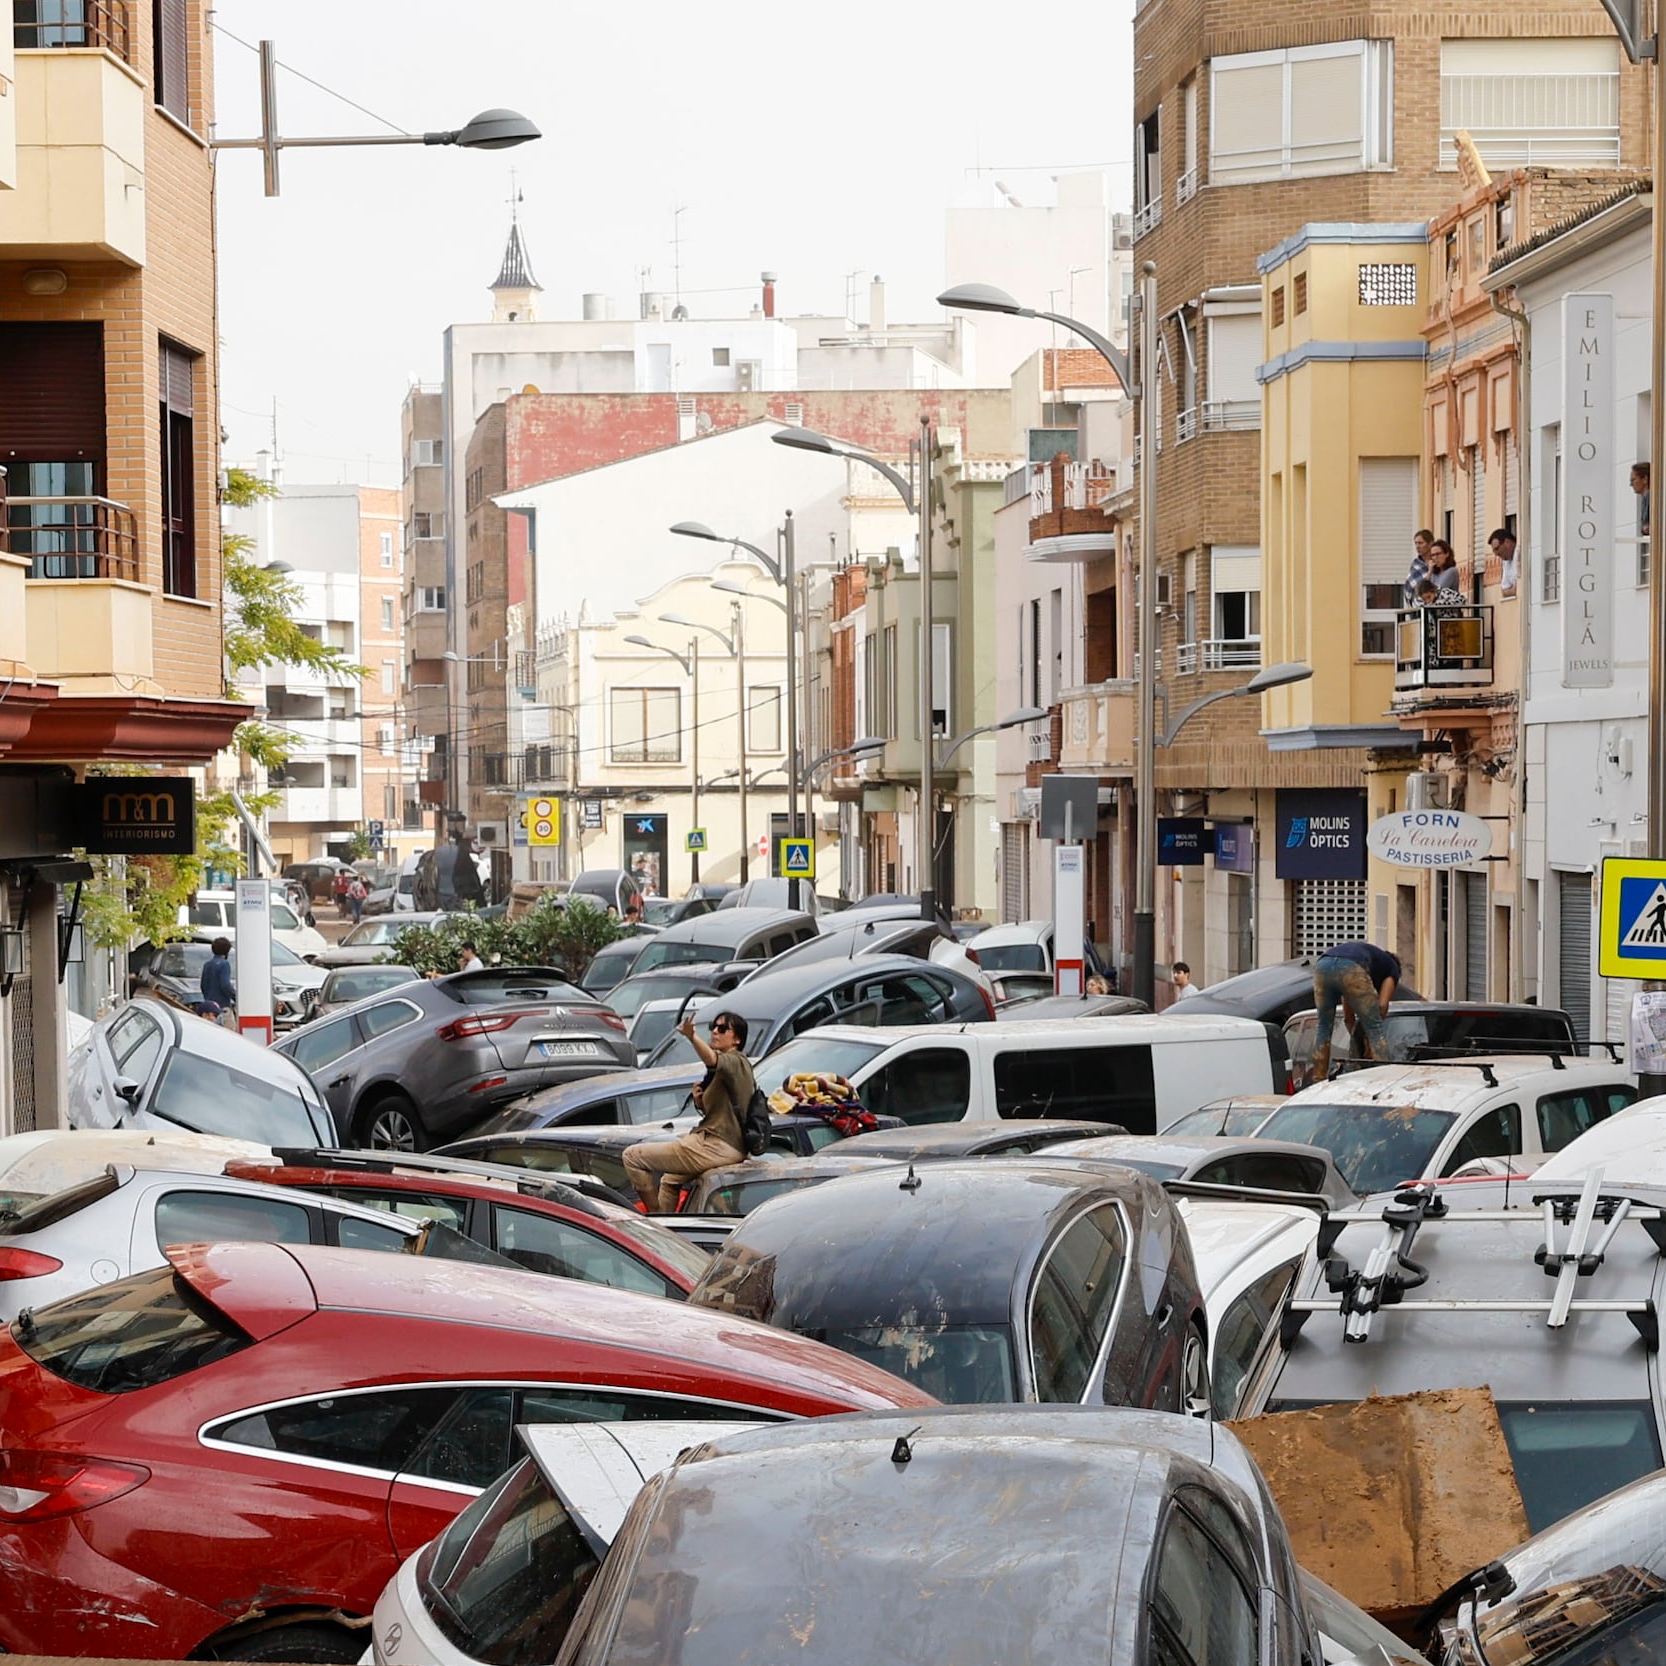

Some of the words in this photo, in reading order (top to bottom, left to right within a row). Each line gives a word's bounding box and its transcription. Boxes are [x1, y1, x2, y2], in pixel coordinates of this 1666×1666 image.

[1577, 309, 1600, 462] EMILIO
[1577, 494, 1597, 646] ROTGLÁ
[1568, 658, 1609, 672] JEWELS
[537, 824, 551, 834] 30
[1309, 816, 1351, 831] MOLINS
[1402, 813, 1461, 829] FORN
[102, 829, 176, 840] INTERIORISMO
[1309, 831, 1351, 849] ÒPTICS
[1378, 825, 1400, 846] La
[1385, 848, 1474, 865] PASTISSERIA
